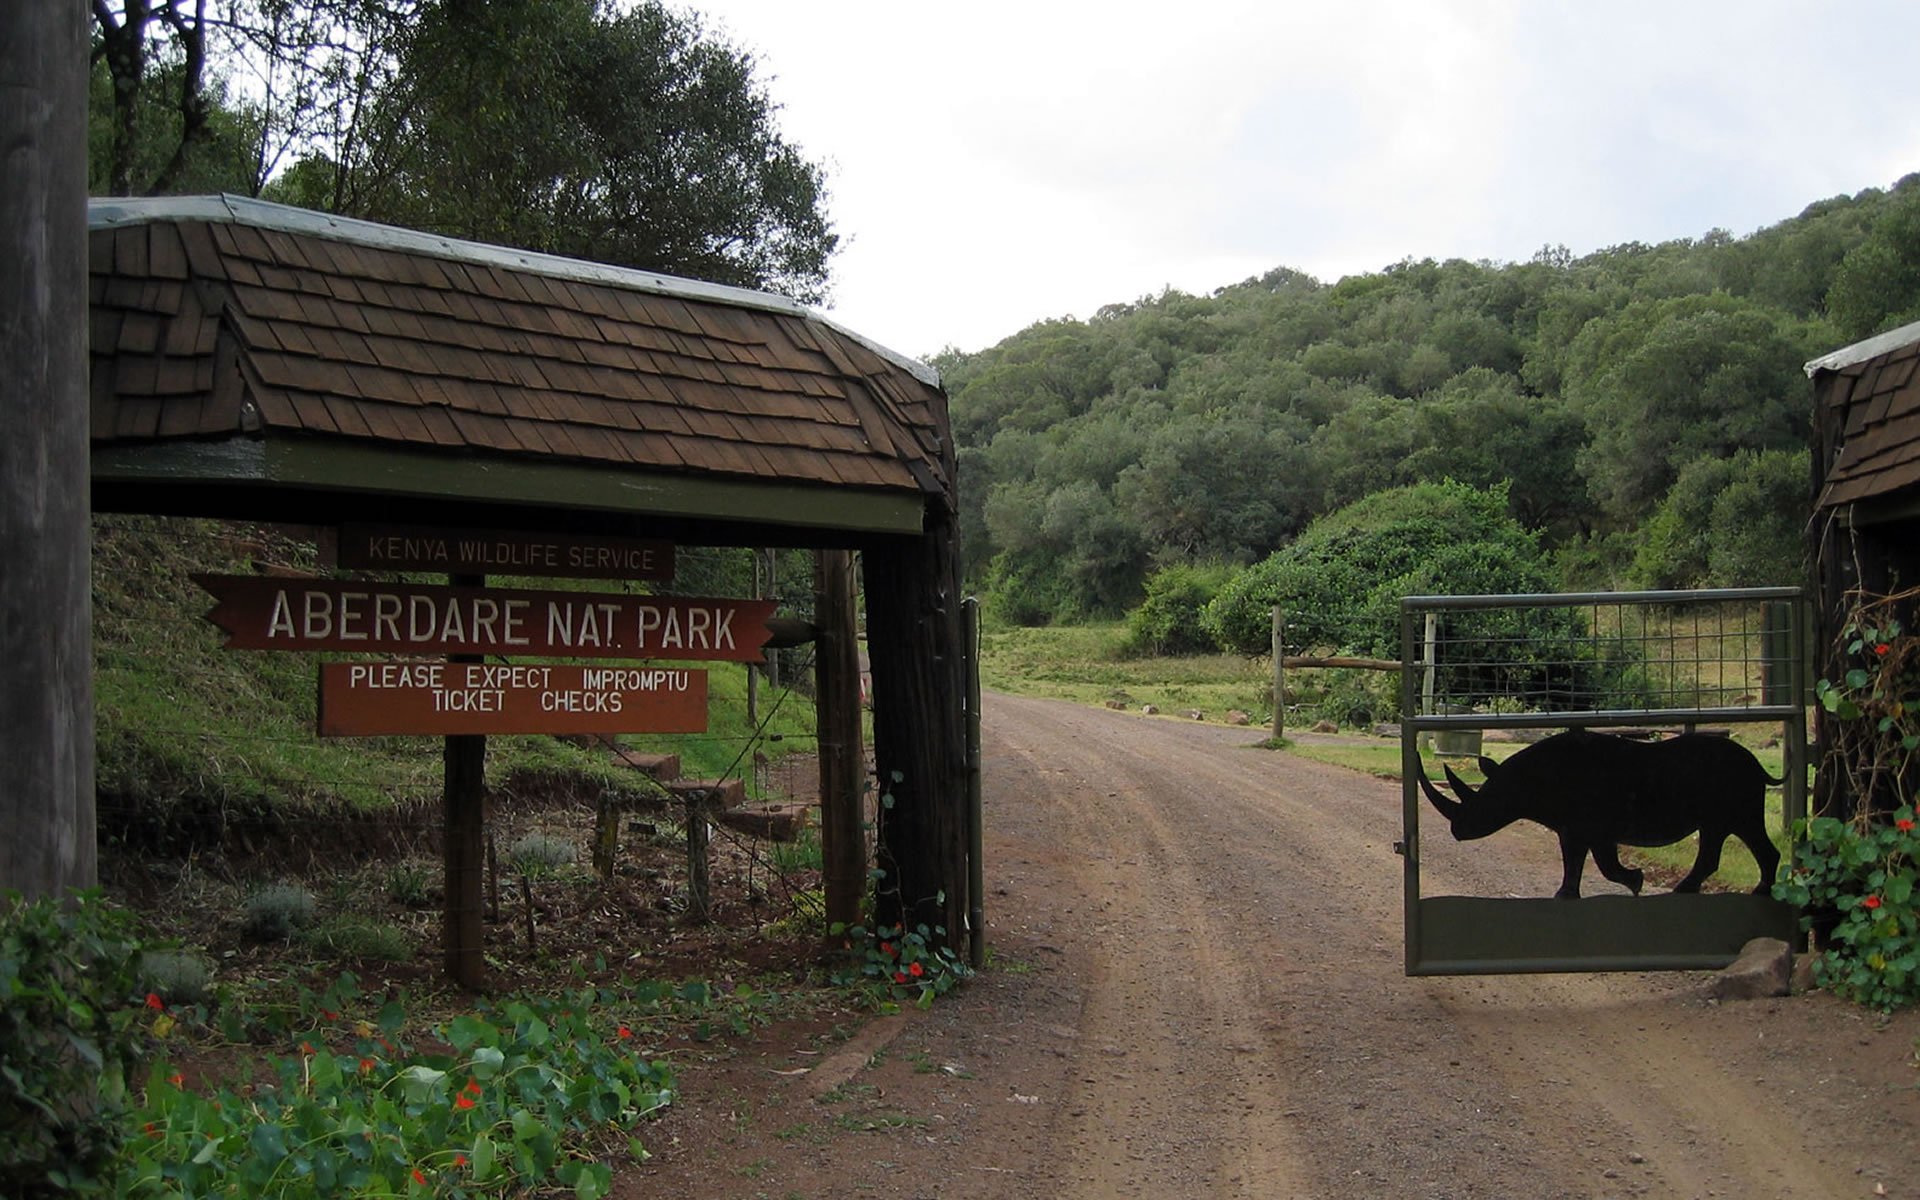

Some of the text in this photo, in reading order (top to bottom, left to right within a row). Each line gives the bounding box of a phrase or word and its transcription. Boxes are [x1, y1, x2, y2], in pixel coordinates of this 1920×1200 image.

[369, 537, 655, 571] KENYA WILDLIFE SERVICE
[267, 590, 736, 650] ABERDARE NAT. PARK
[350, 666, 689, 692] PLEASE EXPECT IMPROMPTU
[433, 690, 623, 714] TICKET CHECKS
